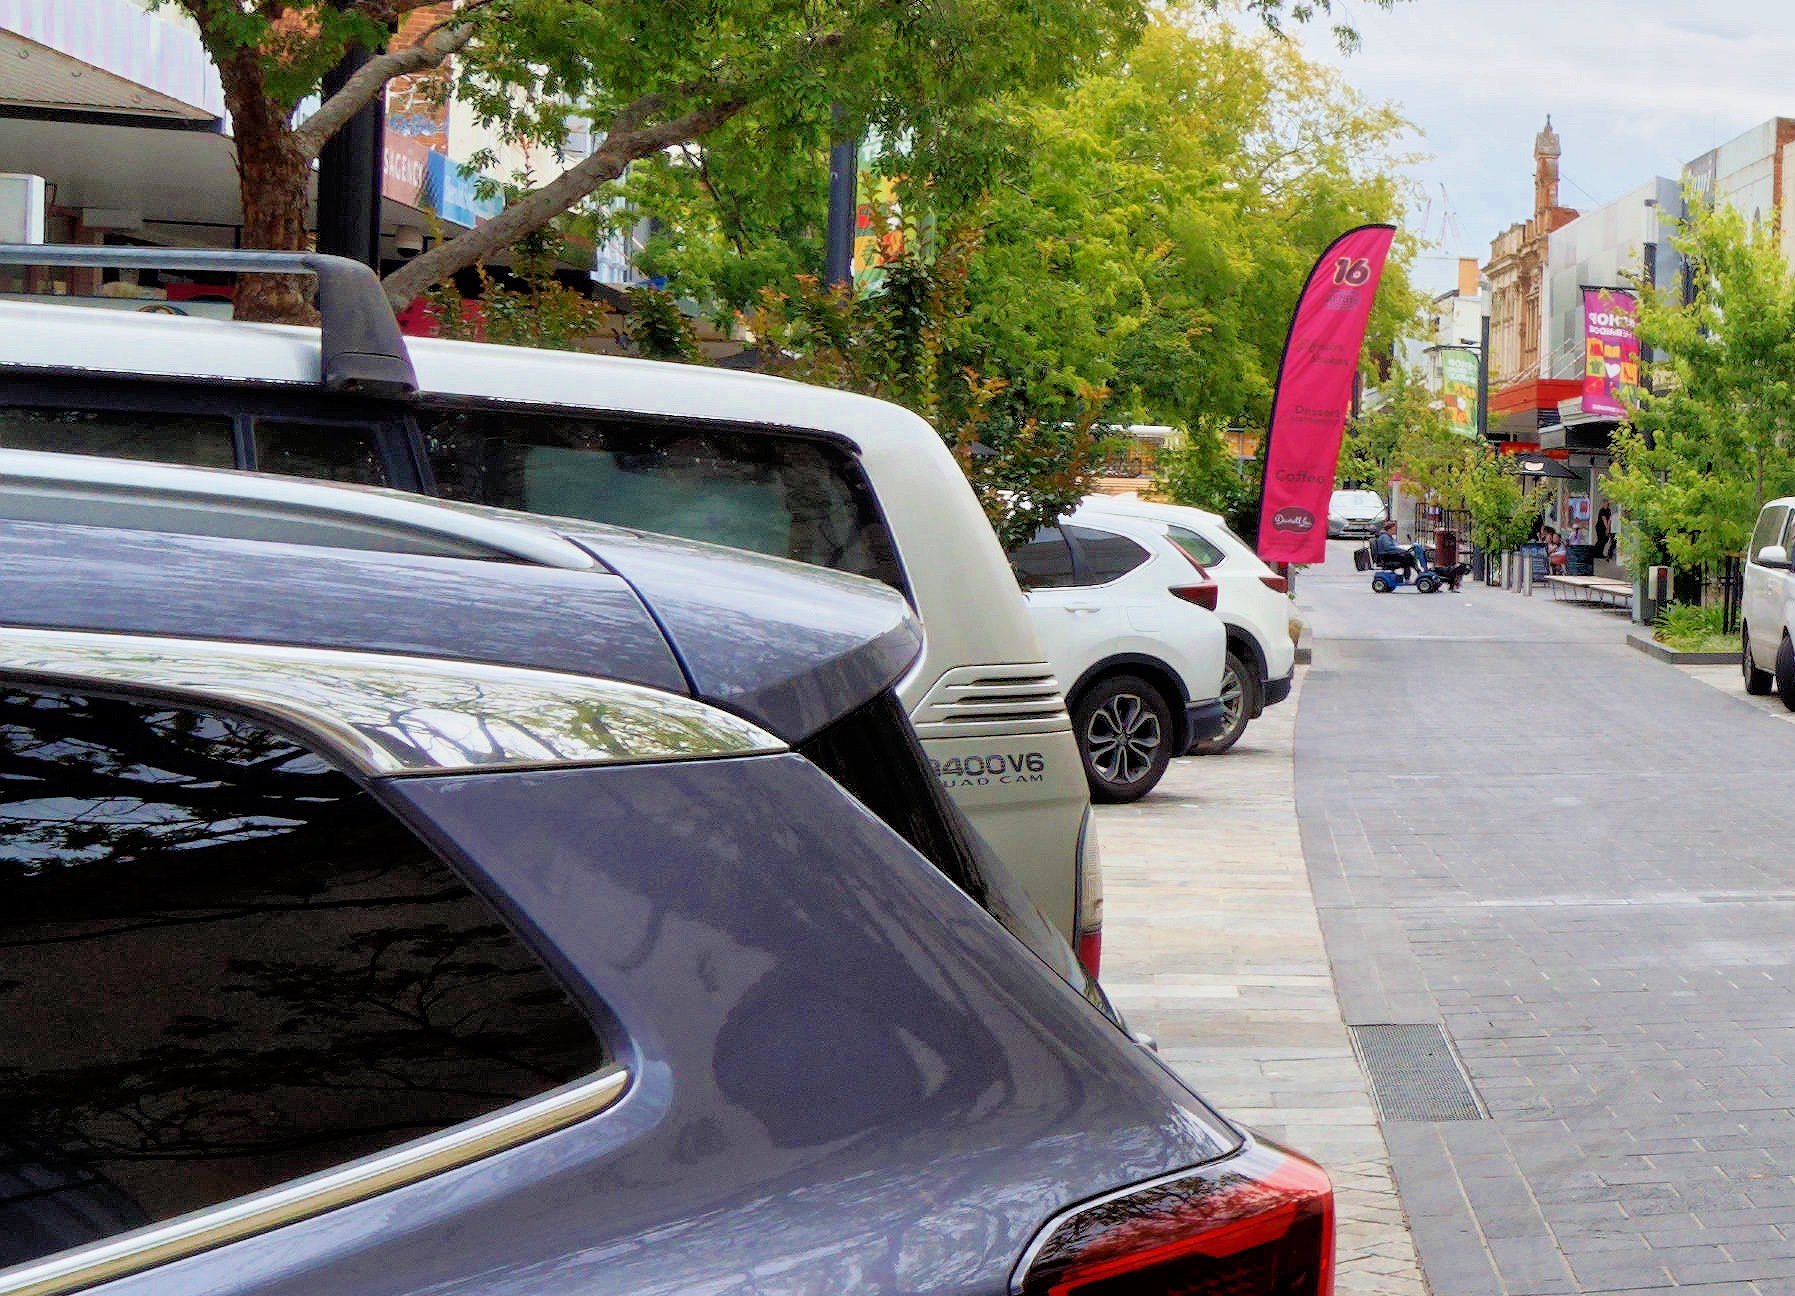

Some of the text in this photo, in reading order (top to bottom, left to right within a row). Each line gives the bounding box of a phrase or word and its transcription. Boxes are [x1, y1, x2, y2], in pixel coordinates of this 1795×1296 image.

[1333, 257, 1371, 287] 16
[1275, 469, 1326, 485] Coffee
[1000, 774, 1043, 784] CAM
